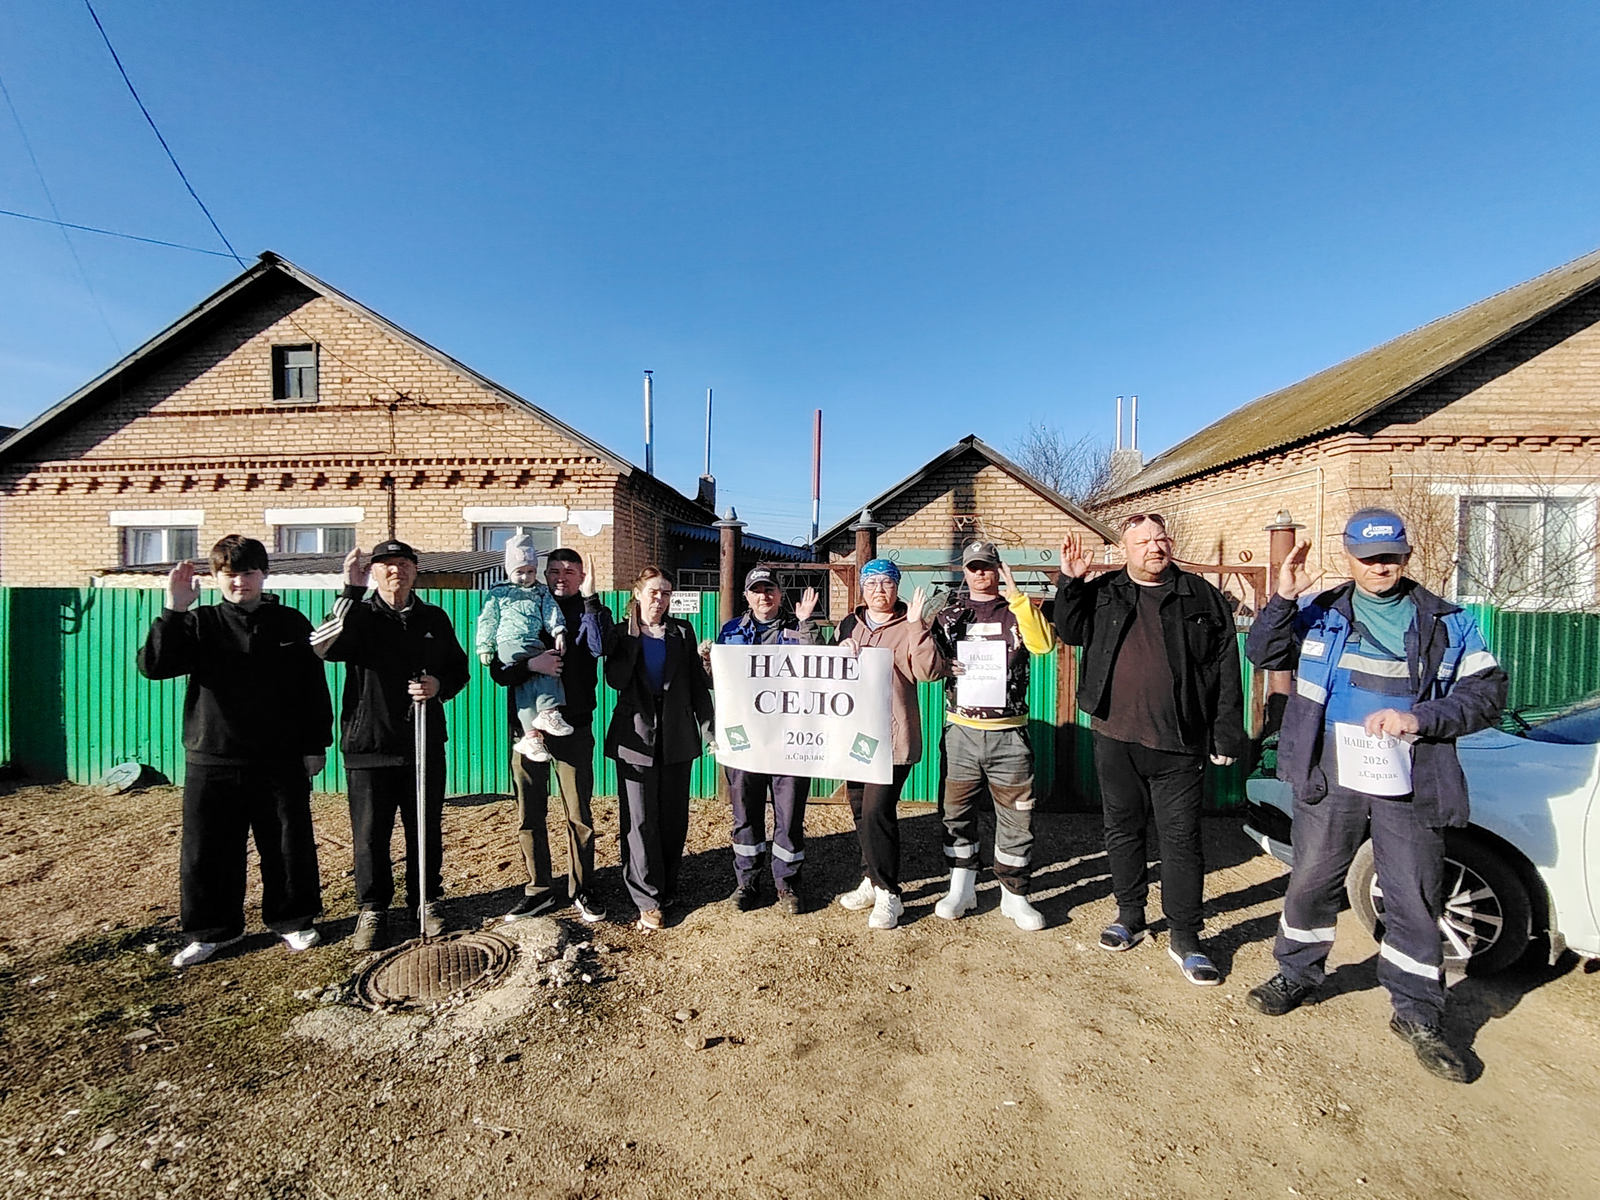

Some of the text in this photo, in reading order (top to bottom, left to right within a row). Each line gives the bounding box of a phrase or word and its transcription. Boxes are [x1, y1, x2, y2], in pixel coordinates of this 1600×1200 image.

[747, 654, 860, 681] НАШЕ
[754, 690, 855, 717] СЕЛО
[786, 731, 824, 746] 2026
[1343, 736, 1374, 749] НАШЕ
[1362, 755, 1389, 766] 2026
